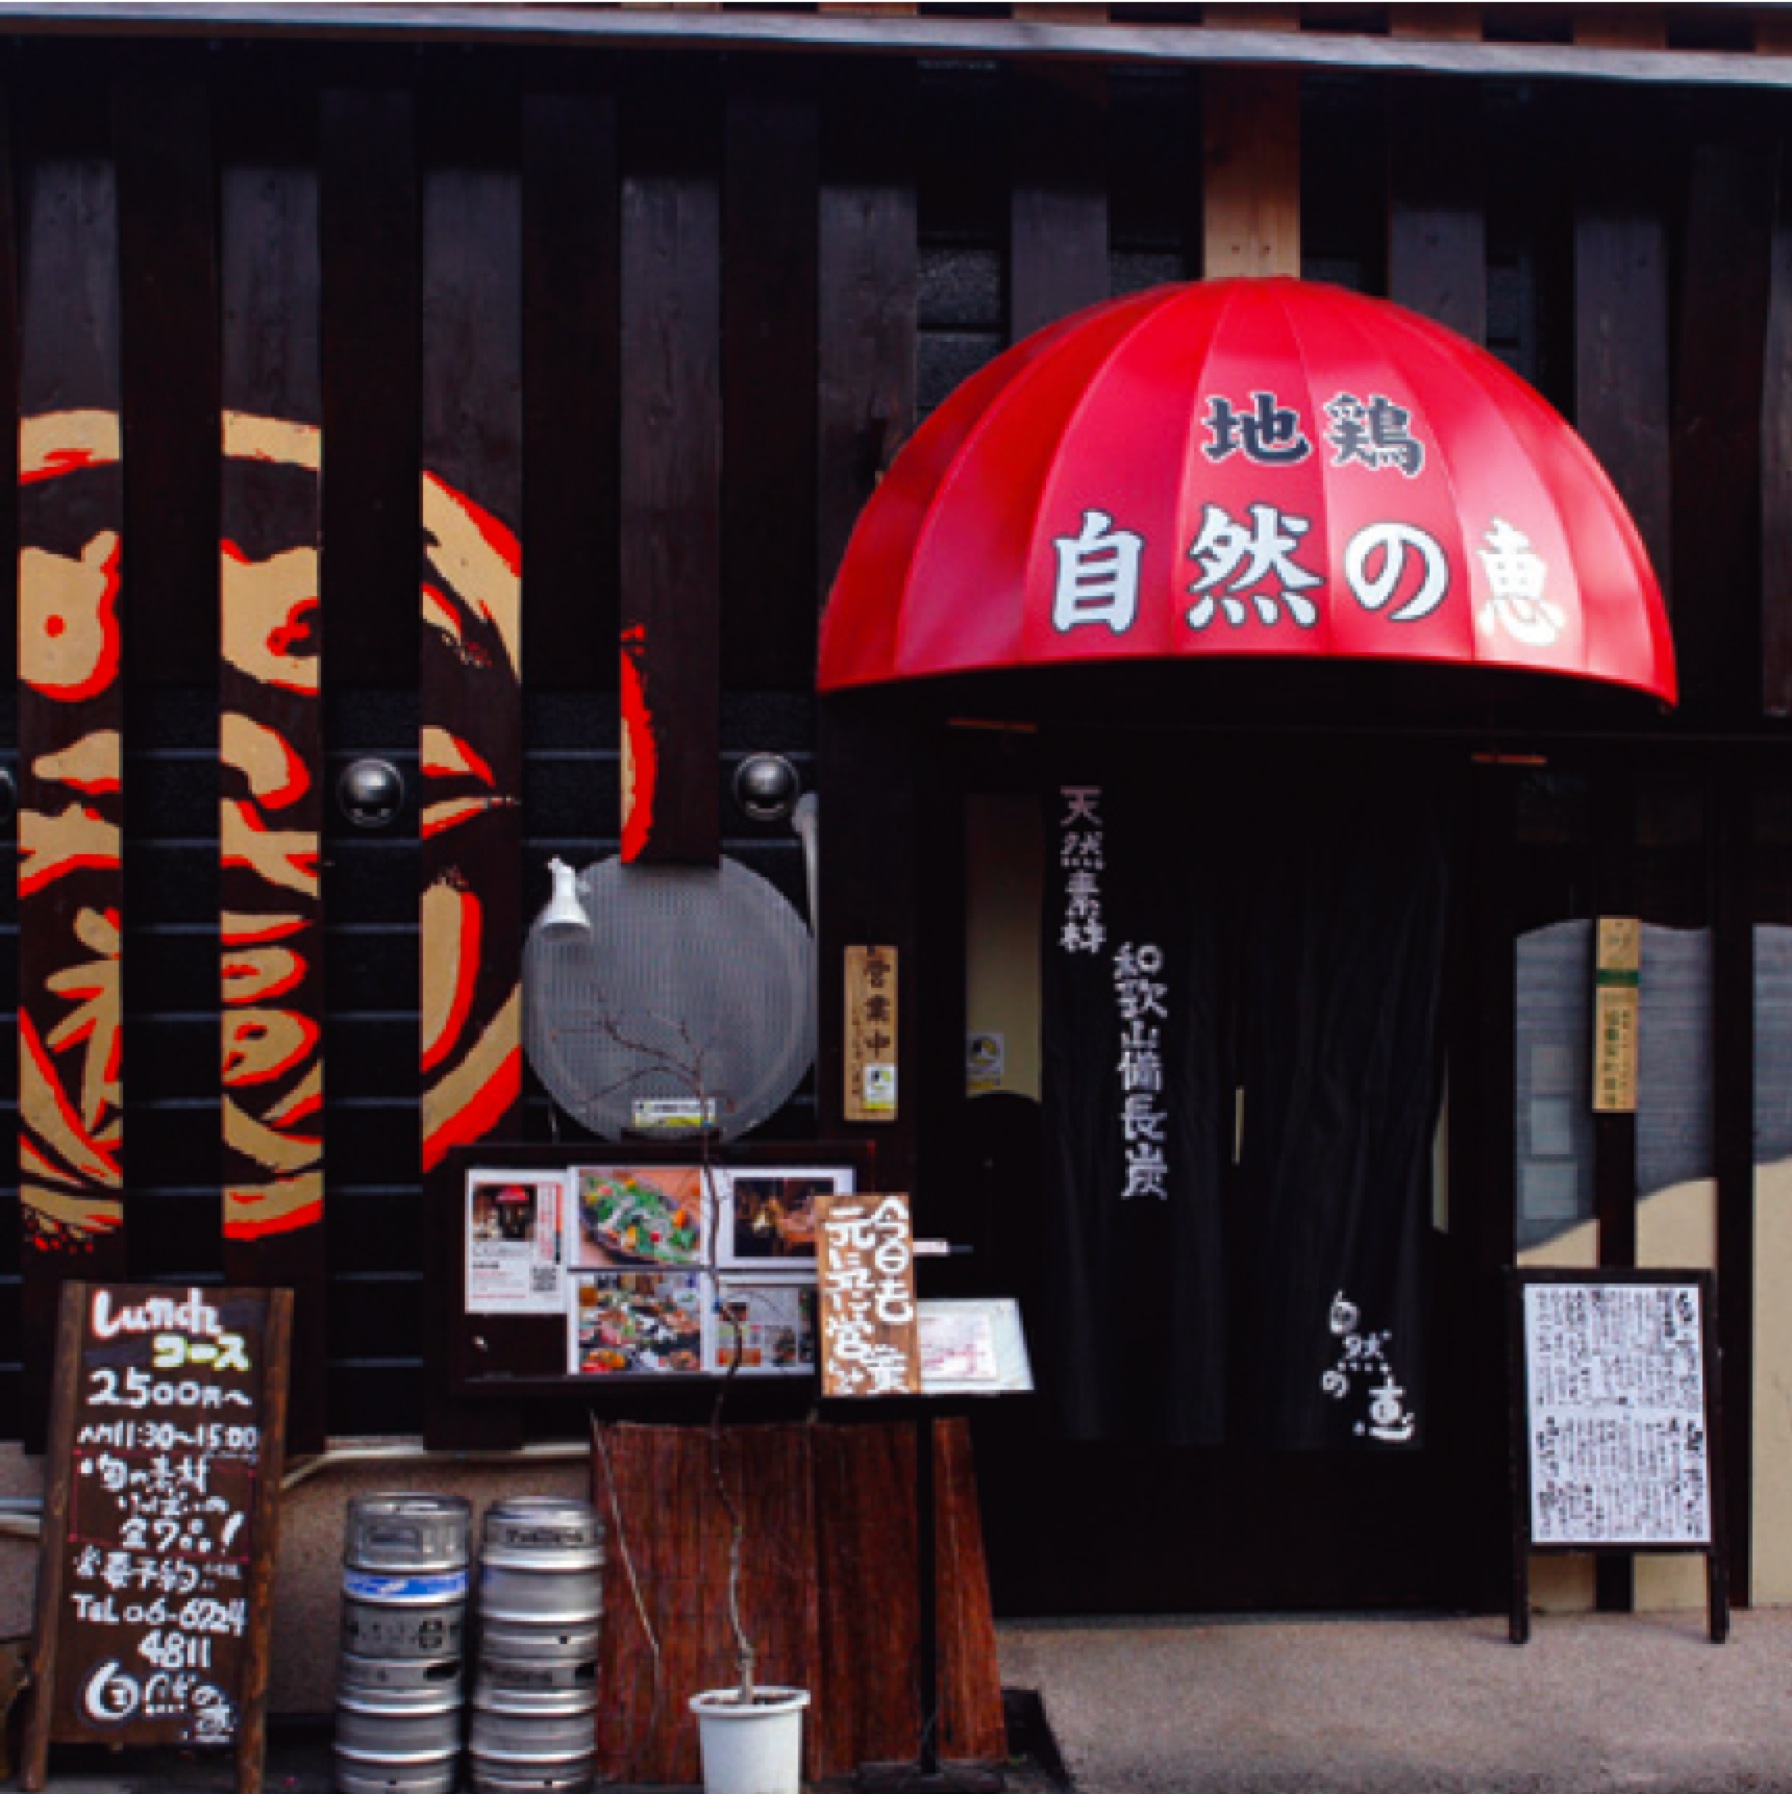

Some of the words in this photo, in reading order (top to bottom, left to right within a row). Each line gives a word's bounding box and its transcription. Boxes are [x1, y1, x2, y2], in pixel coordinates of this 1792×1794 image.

[1203, 392, 1424, 476] 地鶏
[1051, 503, 1566, 646] 自然の恵
[1058, 784, 1107, 954] 天然素材
[863, 958, 891, 1061] 営業中
[1112, 941, 1169, 1201] 和歌山備長炭
[92, 1287, 224, 1340] Lunch
[872, 1195, 915, 1325] 今日も
[152, 1333, 251, 1371] コース
[1320, 1289, 1416, 1443] 自然の恵
[137, 1629, 212, 1669] 4811
